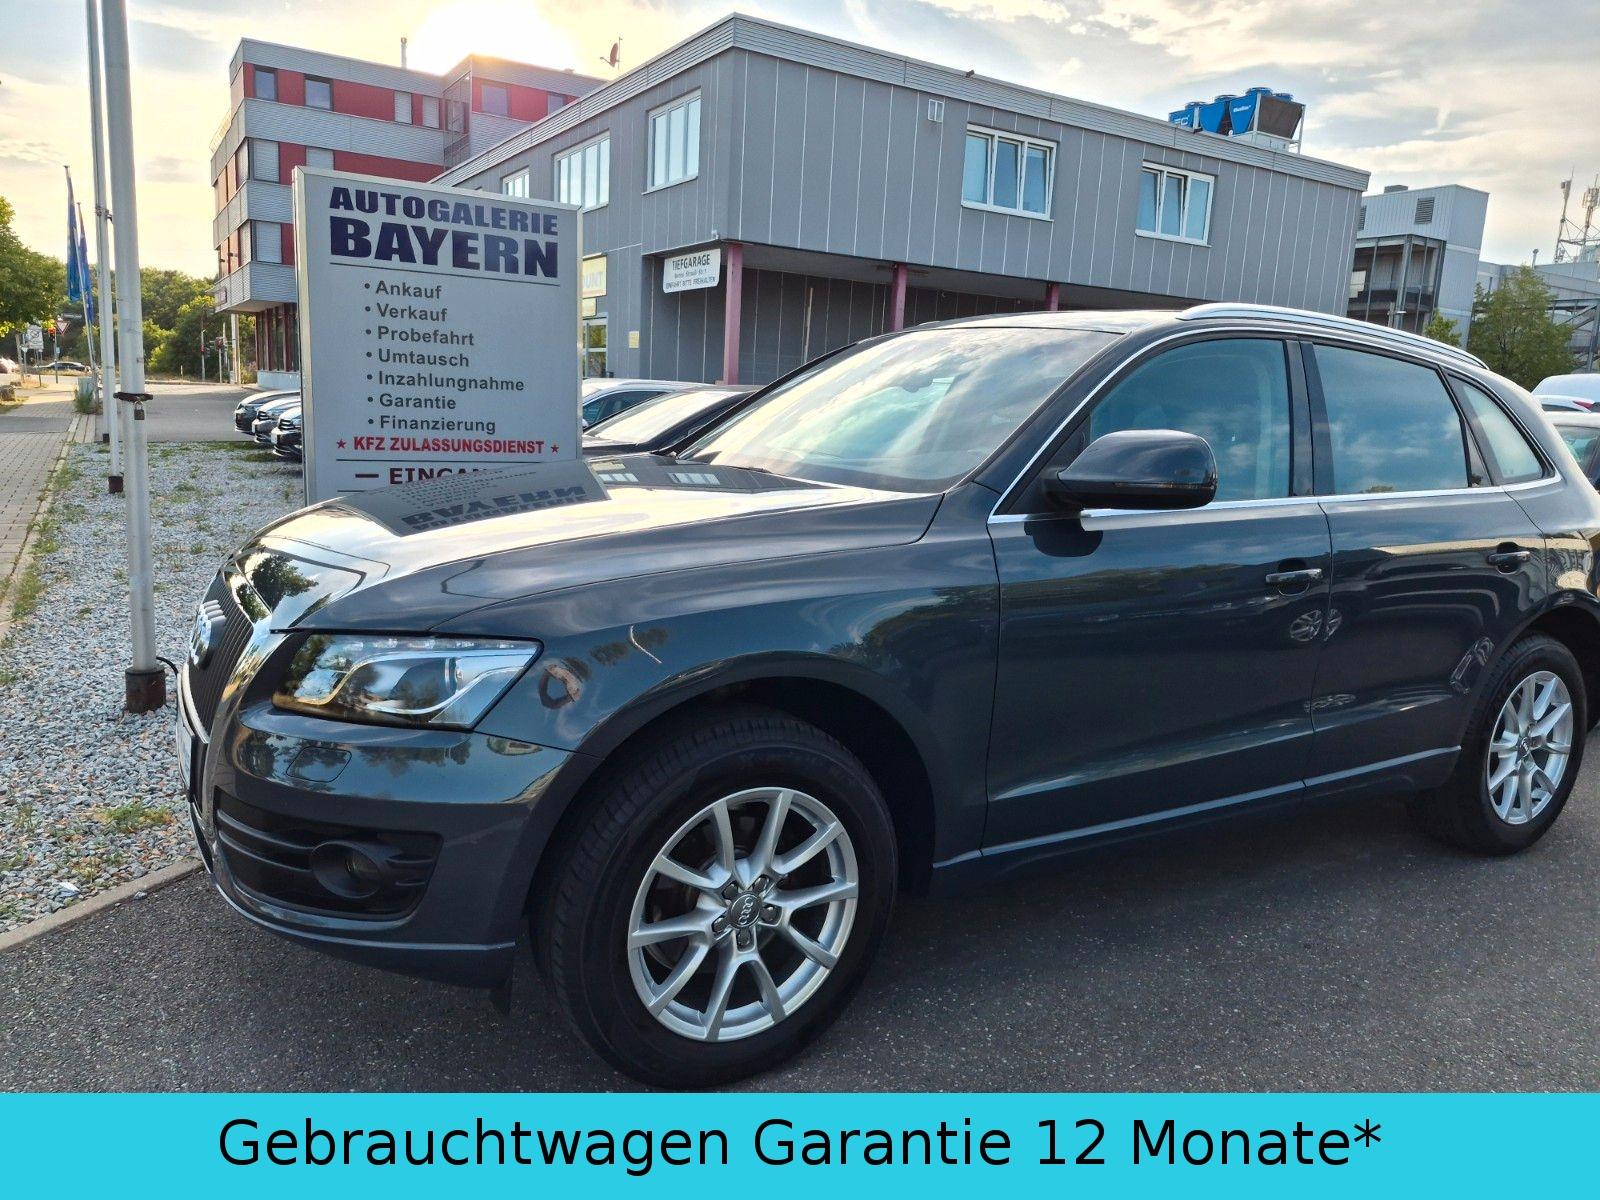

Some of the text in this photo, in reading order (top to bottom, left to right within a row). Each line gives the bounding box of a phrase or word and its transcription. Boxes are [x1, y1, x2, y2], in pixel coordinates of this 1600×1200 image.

[329, 186, 559, 236] AUTOGALERIE
[329, 215, 559, 278] BAYERN
[672, 254, 711, 270] TIEFGARAGE
[375, 280, 442, 299] Ankauf
[376, 302, 447, 322] Verkauf
[377, 325, 475, 346] Probefahrt
[378, 348, 469, 368] Umtausch
[378, 370, 525, 392] Inzahlungnahme
[379, 393, 457, 410] Garantie
[380, 415, 496, 435] Finanzierung
[353, 436, 545, 454] KFZ ZULASSUNGSDIENST
